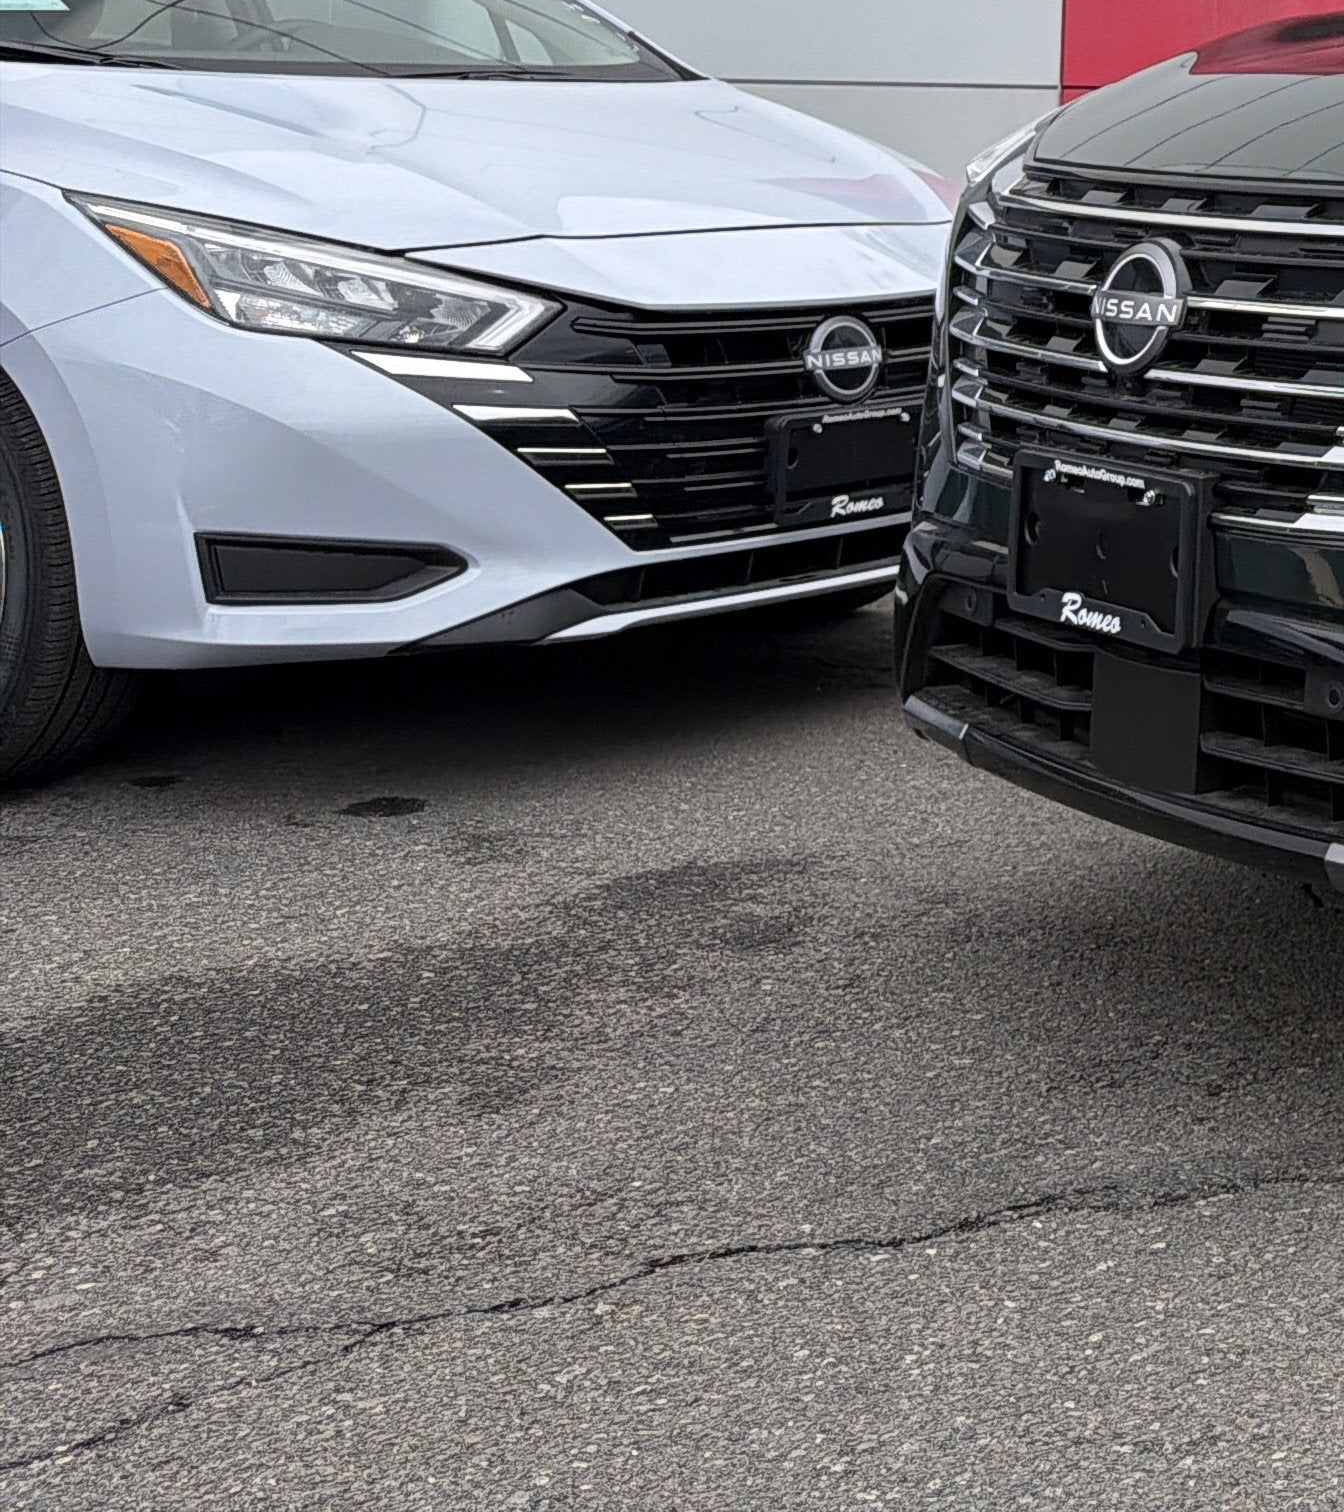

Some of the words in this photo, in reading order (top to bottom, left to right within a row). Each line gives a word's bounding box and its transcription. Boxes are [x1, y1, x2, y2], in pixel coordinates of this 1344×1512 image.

[1093, 296, 1177, 323] NISSAN
[806, 348, 882, 368] NISSAN
[1054, 459, 1146, 489] RomeoAutoGroup.com
[829, 494, 884, 519] Romeo
[1060, 592, 1122, 634] Romeo
